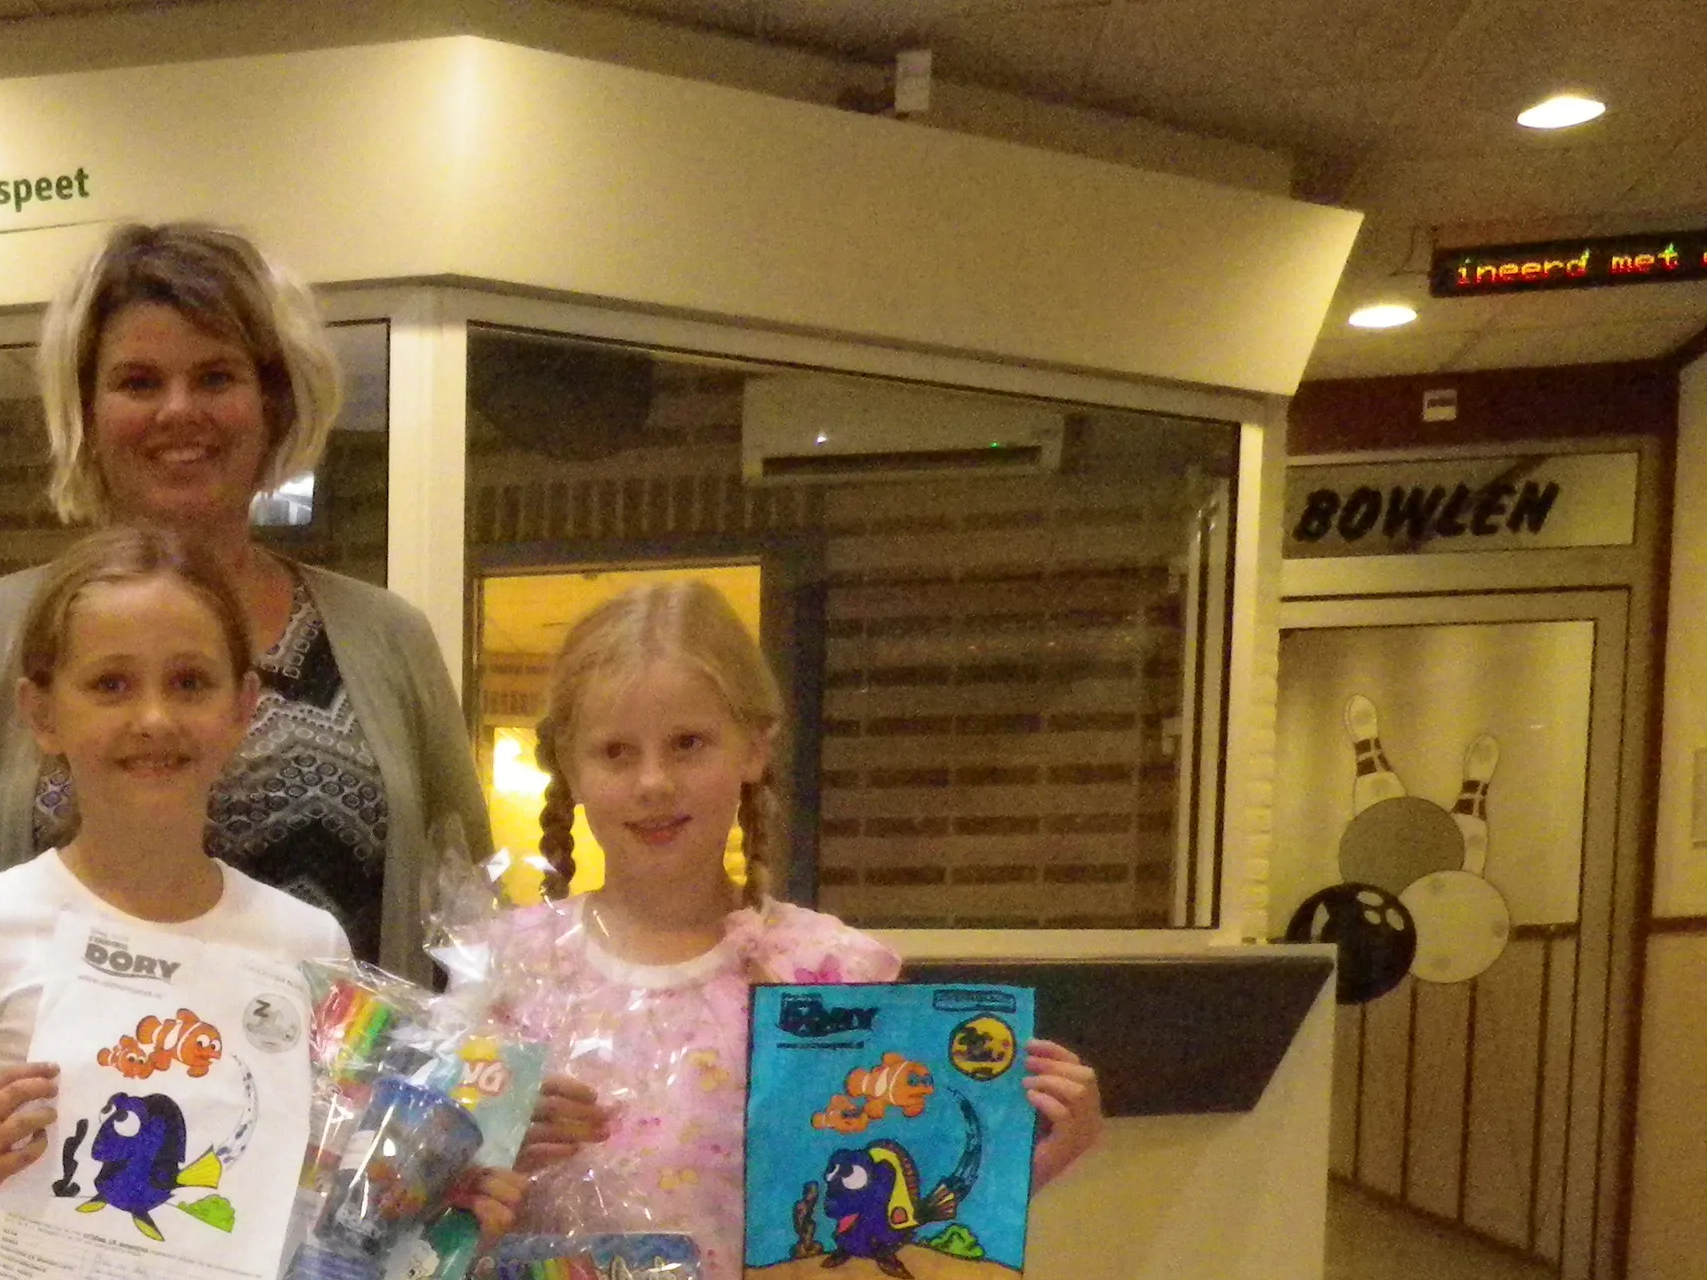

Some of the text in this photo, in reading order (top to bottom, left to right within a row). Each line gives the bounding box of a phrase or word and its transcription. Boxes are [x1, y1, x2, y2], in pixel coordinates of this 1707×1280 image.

[1610, 242, 1679, 274] met
[1293, 479, 1560, 543] BOWLEN
[84, 943, 182, 979] DORY
